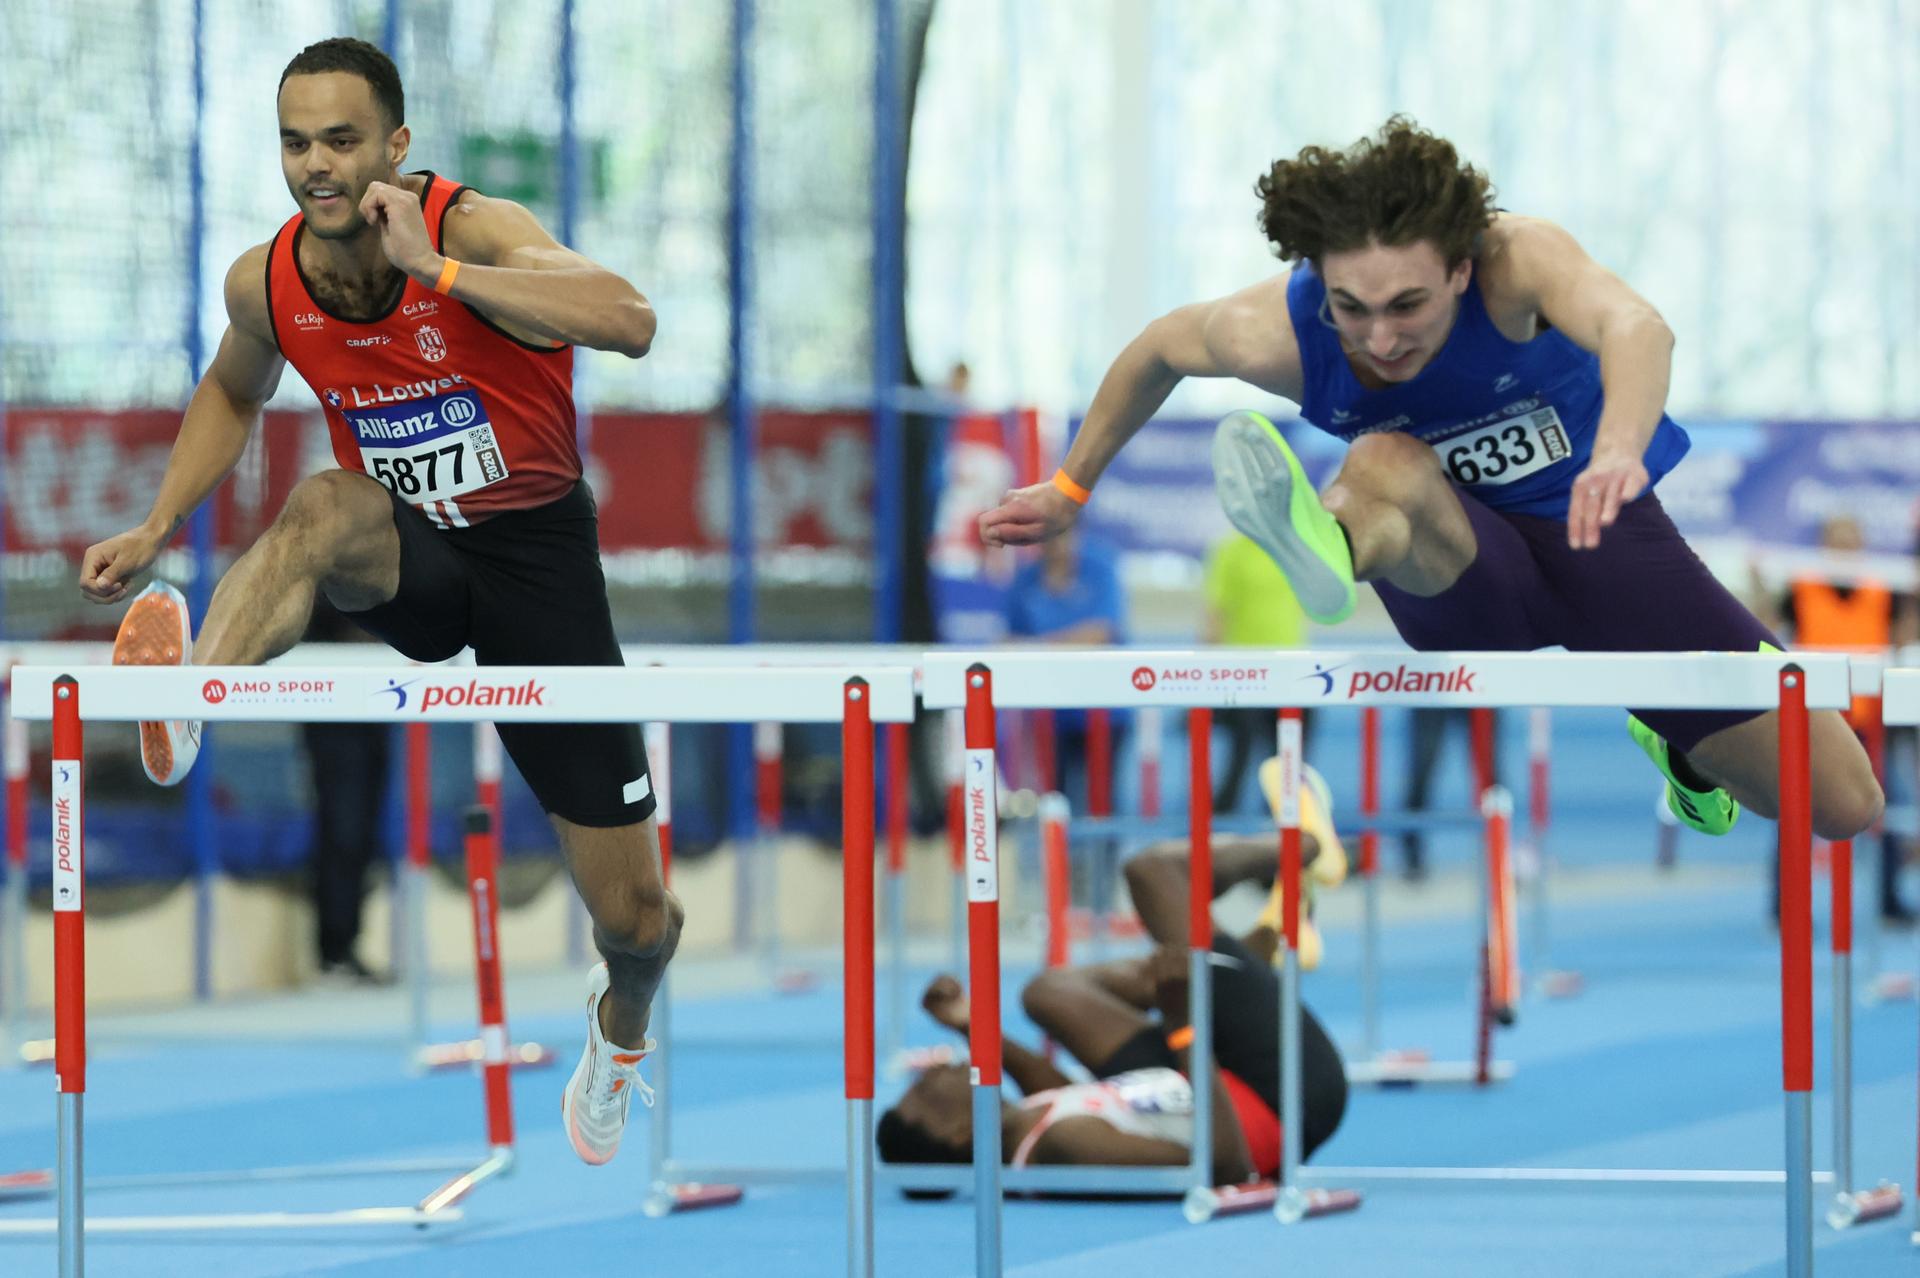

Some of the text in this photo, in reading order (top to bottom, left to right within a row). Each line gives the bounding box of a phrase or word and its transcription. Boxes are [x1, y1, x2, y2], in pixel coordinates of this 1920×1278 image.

[346, 336, 381, 347] CRAFT
[355, 411, 439, 439] Allianz
[372, 442, 465, 495] 5877
[481, 451, 500, 481] 2026
[1447, 424, 1536, 486] 633
[231, 681, 335, 693] AMO SPORT
[1162, 668, 1269, 681] AMO SPORT
[1348, 664, 1477, 699] polanik
[420, 679, 547, 713] polanik
[55, 798, 75, 873] polanik
[970, 787, 991, 863] polanik
